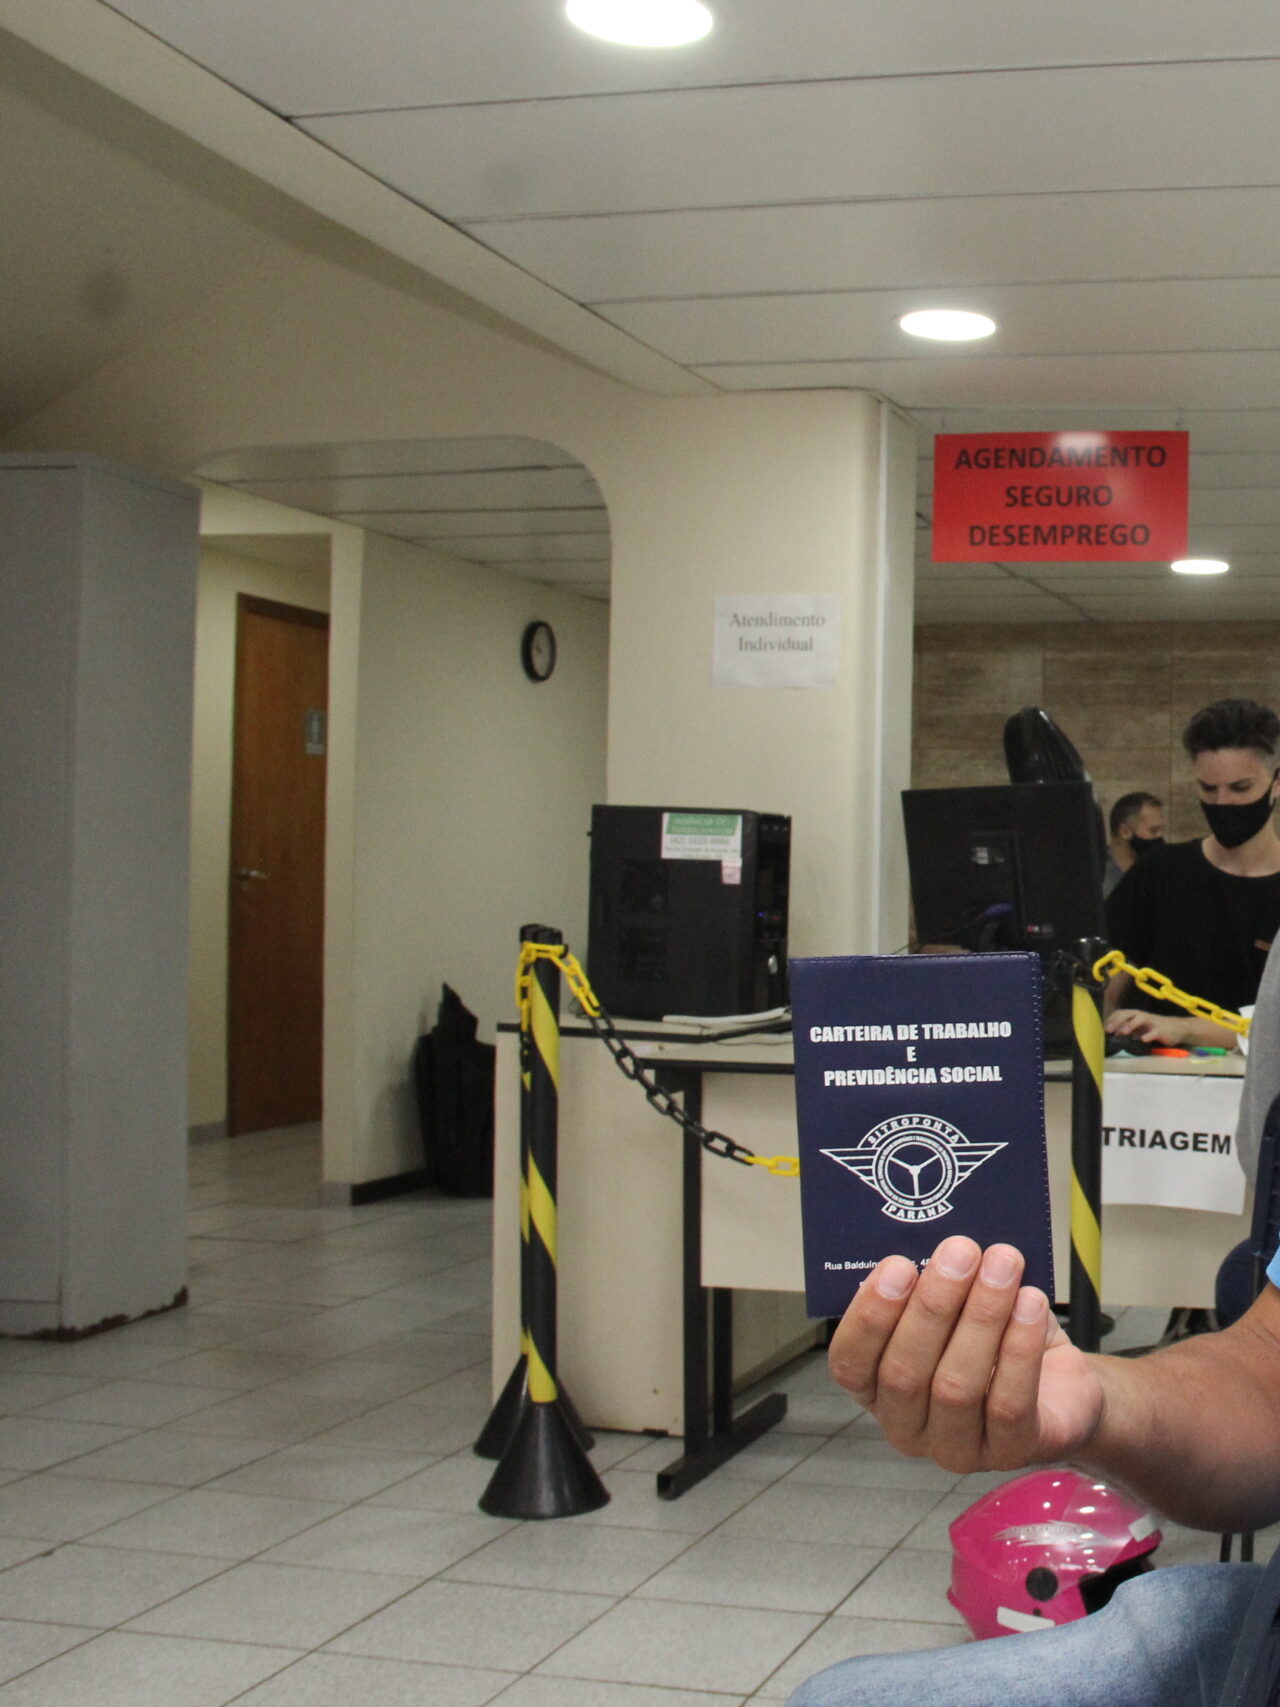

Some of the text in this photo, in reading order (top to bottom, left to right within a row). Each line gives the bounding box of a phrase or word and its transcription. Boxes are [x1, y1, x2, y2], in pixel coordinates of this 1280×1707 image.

[955, 444, 1168, 469] AGENDAMENTO
[1005, 485, 1113, 508] SEGURO
[968, 523, 1150, 546] DESEMPREGO
[729, 612, 826, 628] Atendimento
[738, 636, 814, 652] Individual
[809, 1021, 1012, 1043] CARTEIRA DE TRABALHO
[906, 1046, 917, 1063] E
[823, 1066, 1003, 1087] PREVIDÊNCIA SOCIAL
[867, 1117, 960, 1145] SITROPONTA
[1102, 1126, 1231, 1155] TRIAGEM
[824, 1261, 842, 1271] Rua
[844, 1260, 880, 1271] Balduín
